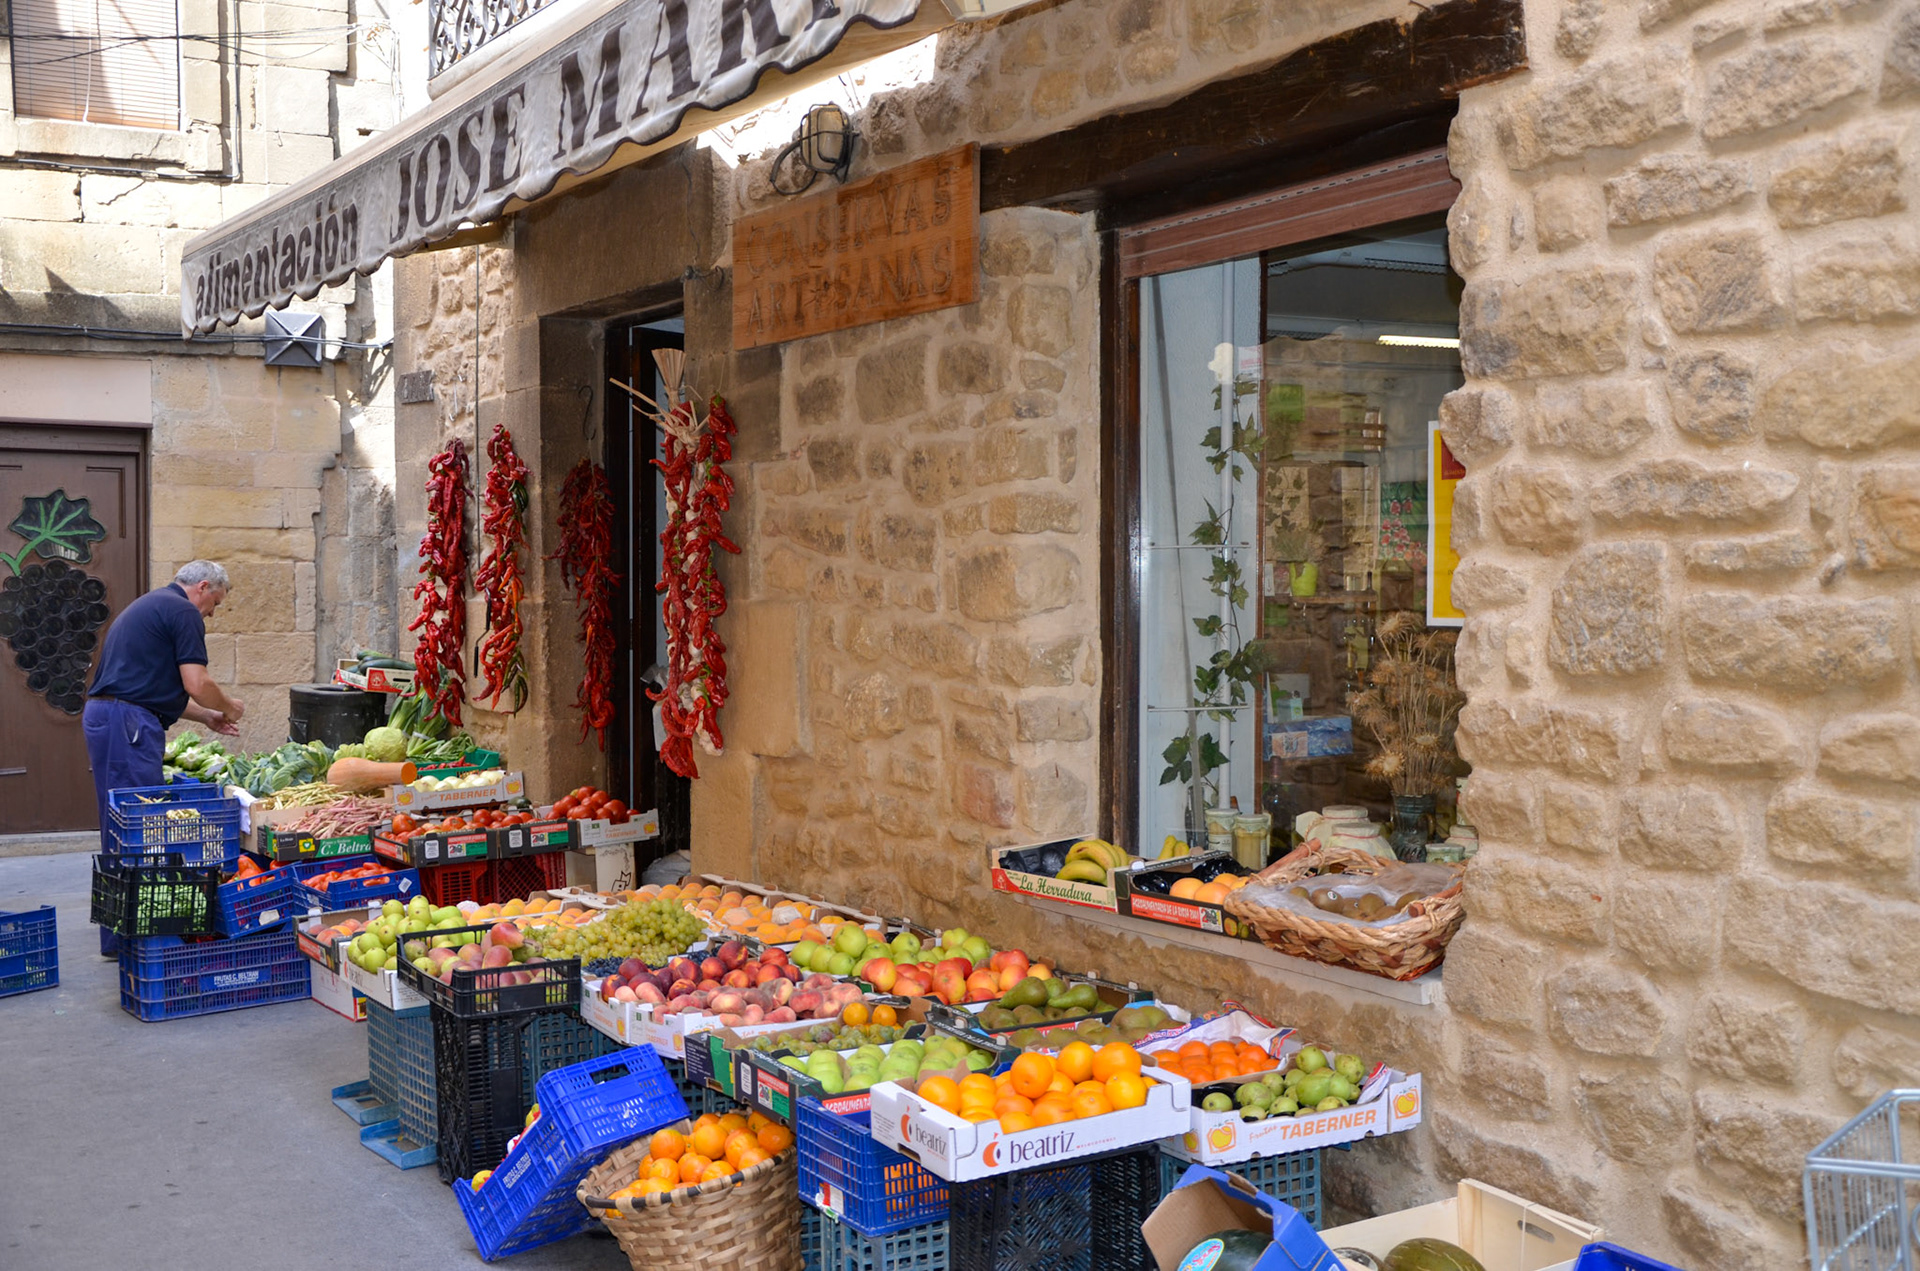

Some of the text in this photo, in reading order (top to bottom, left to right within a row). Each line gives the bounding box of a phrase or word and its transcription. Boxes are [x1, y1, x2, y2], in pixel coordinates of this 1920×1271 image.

[196, 0, 840, 321] alimentación JOSE MAR
[747, 172, 951, 276] CONSERVAS
[746, 237, 951, 334] ARTESANAS
[439, 788, 497, 802] TABERNER
[1019, 874, 1033, 891] La
[1036, 877, 1093, 903] Herradura
[915, 1123, 947, 1155] beatriz
[1280, 1108, 1377, 1140] TABERNER
[1010, 1130, 1075, 1164] beatriz
